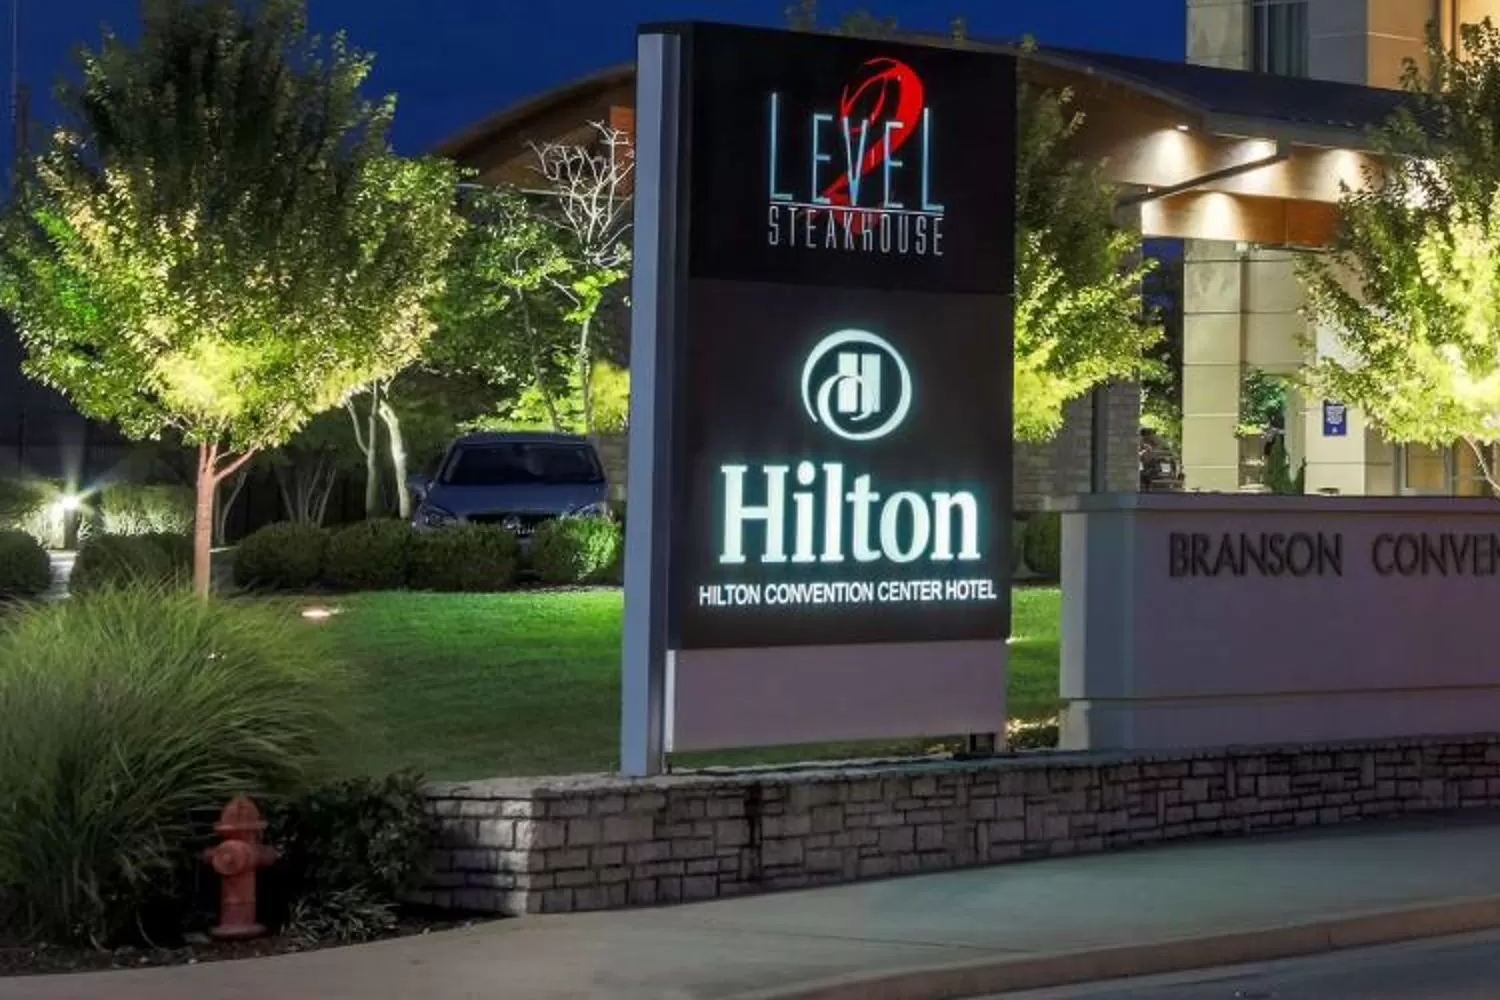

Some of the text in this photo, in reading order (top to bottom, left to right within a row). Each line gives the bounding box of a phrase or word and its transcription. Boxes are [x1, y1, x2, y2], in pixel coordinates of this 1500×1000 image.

[768, 92, 945, 213] LEVEL
[719, 460, 981, 564] Hilton
[699, 578, 997, 606] HILTON CONVENTION CENTER HOTEL
[1167, 532, 1343, 578] BRANSON
